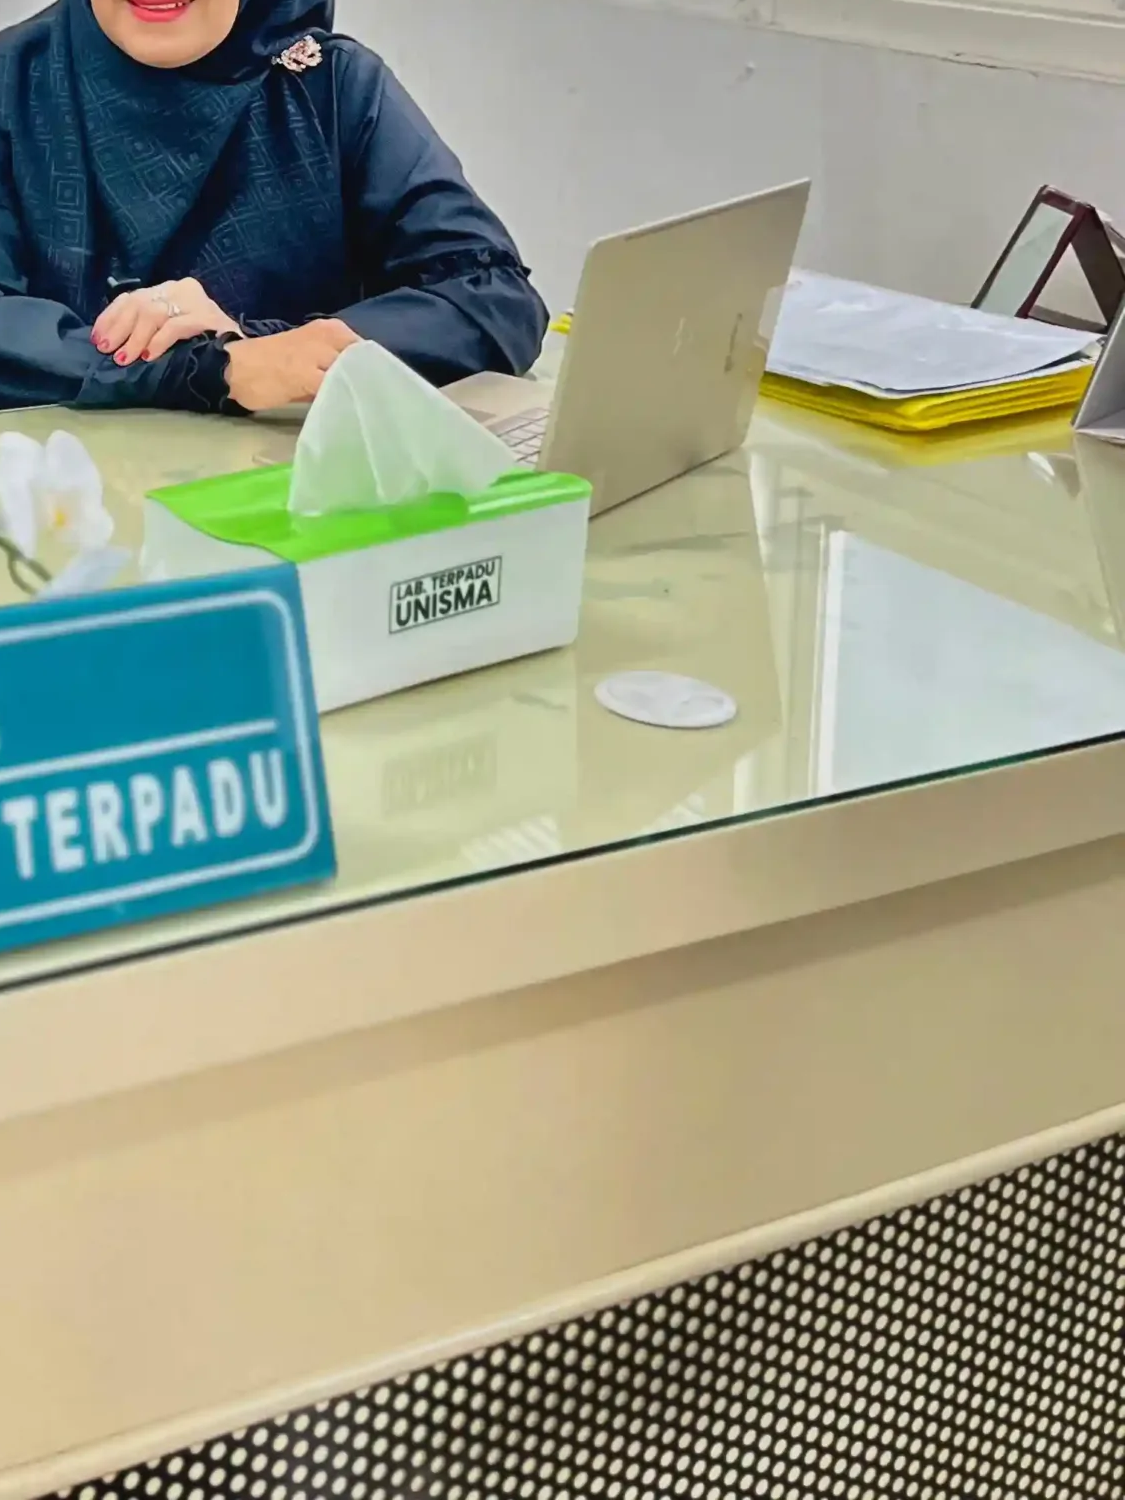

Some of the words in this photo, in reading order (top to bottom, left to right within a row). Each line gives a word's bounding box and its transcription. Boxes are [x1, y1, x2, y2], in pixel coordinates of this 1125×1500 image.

[396, 580, 493, 627] UNISMA
[397, 580, 426, 601] LAB.
[432, 561, 495, 591] TERPADU
[1, 748, 287, 881] TERPADU
